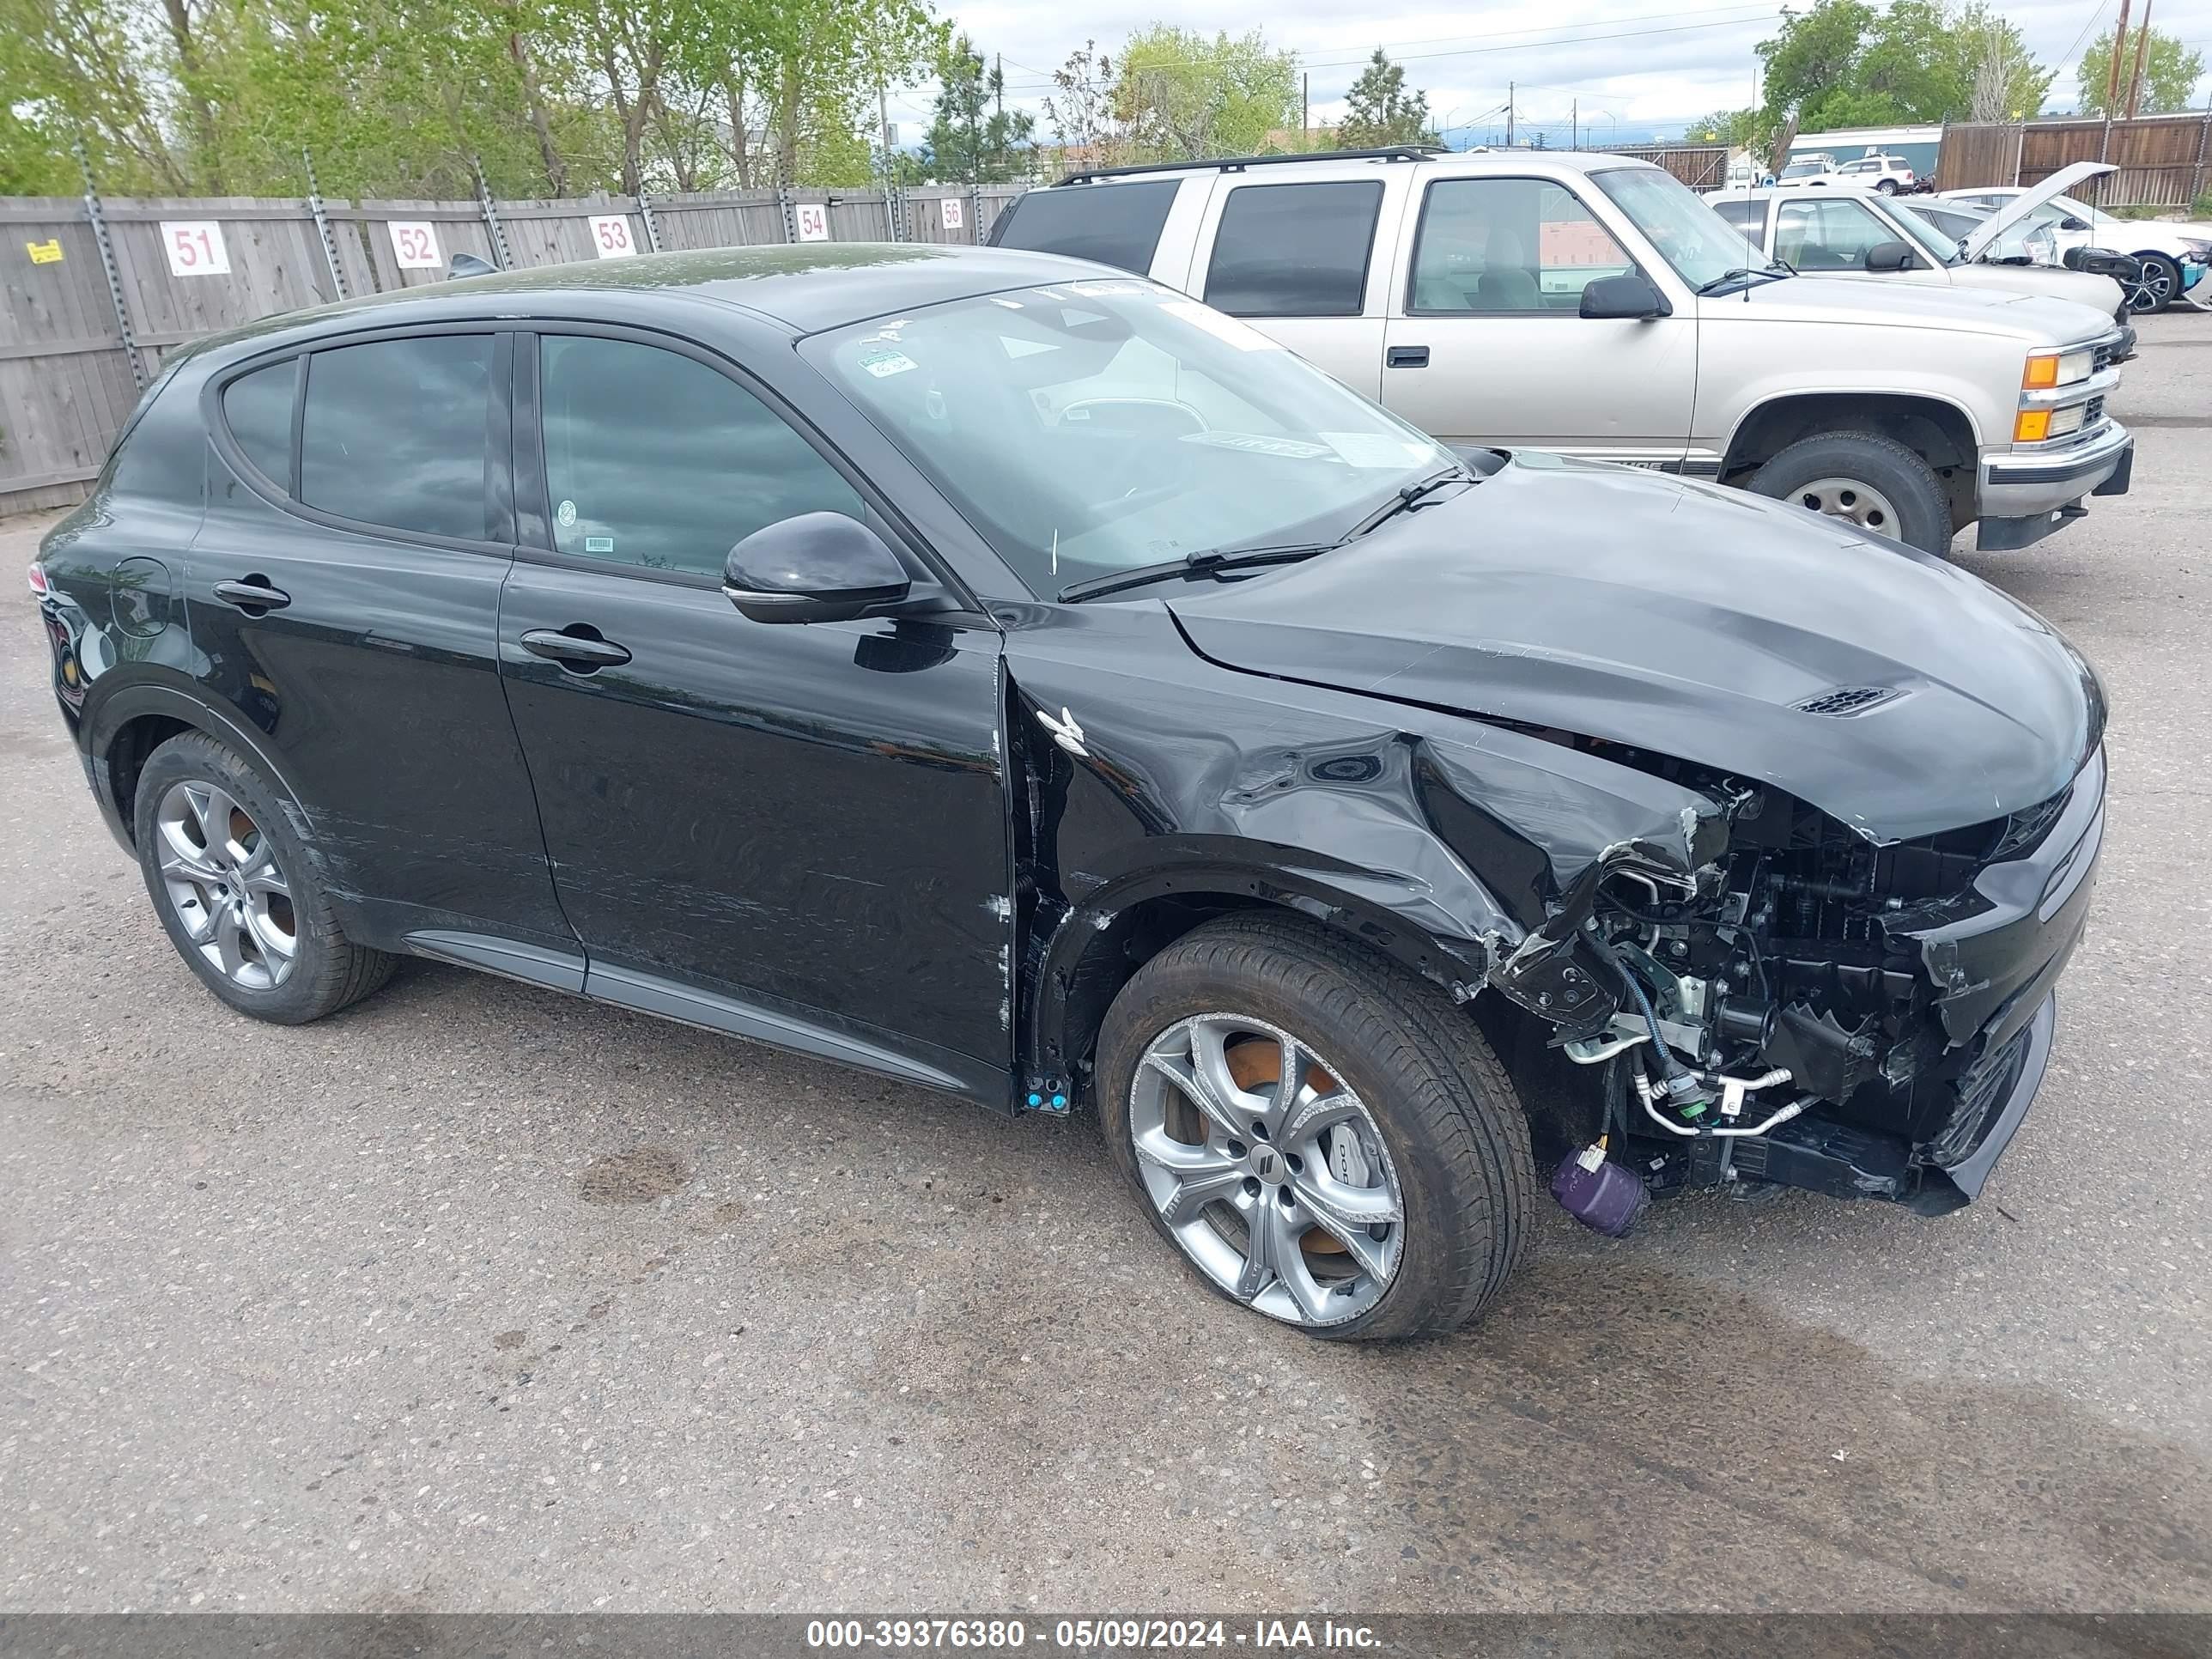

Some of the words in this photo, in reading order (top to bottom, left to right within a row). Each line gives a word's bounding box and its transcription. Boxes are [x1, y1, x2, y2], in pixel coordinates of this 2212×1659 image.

[802, 210, 823, 235] 54
[945, 203, 959, 223] 56
[175, 229, 215, 266] 51
[398, 228, 433, 260] 52
[599, 222, 627, 250] 53
